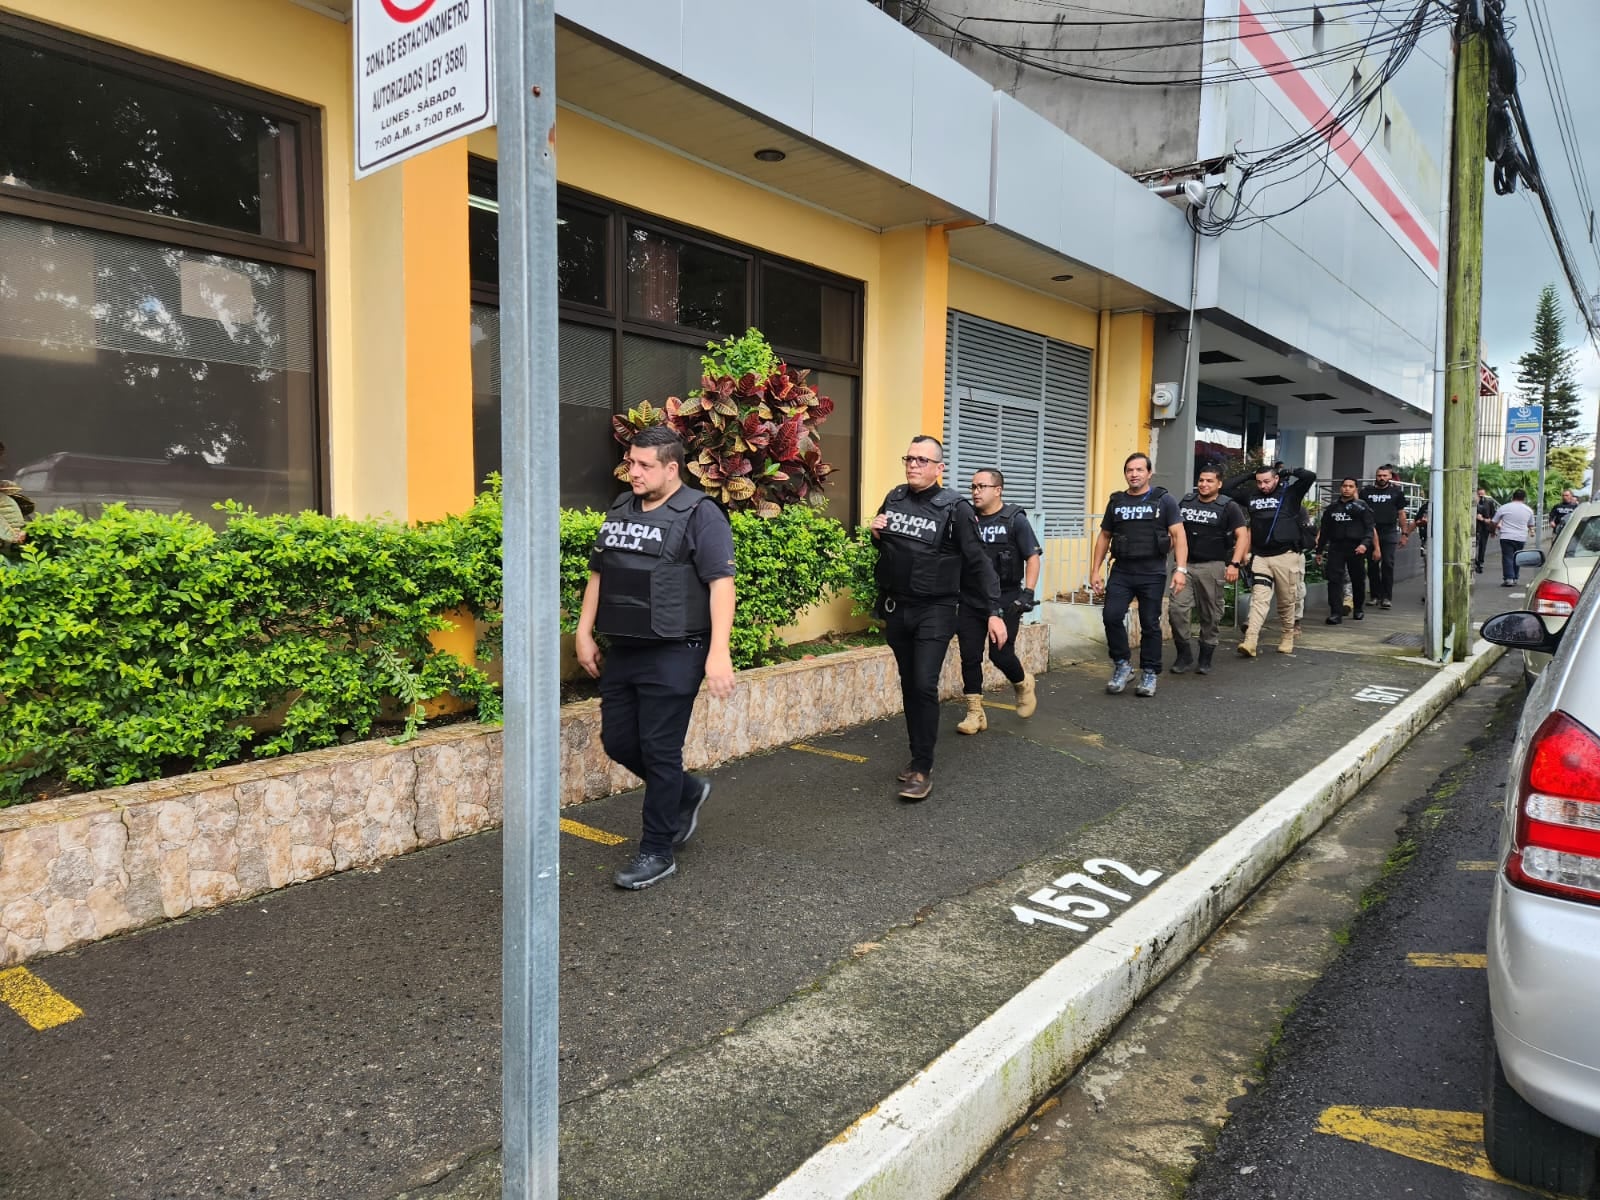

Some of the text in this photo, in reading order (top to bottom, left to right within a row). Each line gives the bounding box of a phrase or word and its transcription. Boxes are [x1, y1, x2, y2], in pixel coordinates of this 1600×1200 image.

[366, 0, 469, 77] ZONA DE ESTACIONOMETRO
[372, 42, 468, 112] AUTORIZADOS (LEY 3580)
[374, 102, 465, 150] 7:00 A.M. a 7:00 P.M.
[381, 108, 410, 130] LUNES
[1518, 440, 1528, 452] E
[1114, 505, 1153, 515] POLICIA
[1181, 507, 1218, 519] POLICIA
[599, 521, 662, 541] POLICIA
[885, 510, 937, 532] POLICIA
[889, 522, 922, 538] O.I.J.
[605, 534, 643, 550] O.I.J.
[1009, 858, 1164, 932] 1572
